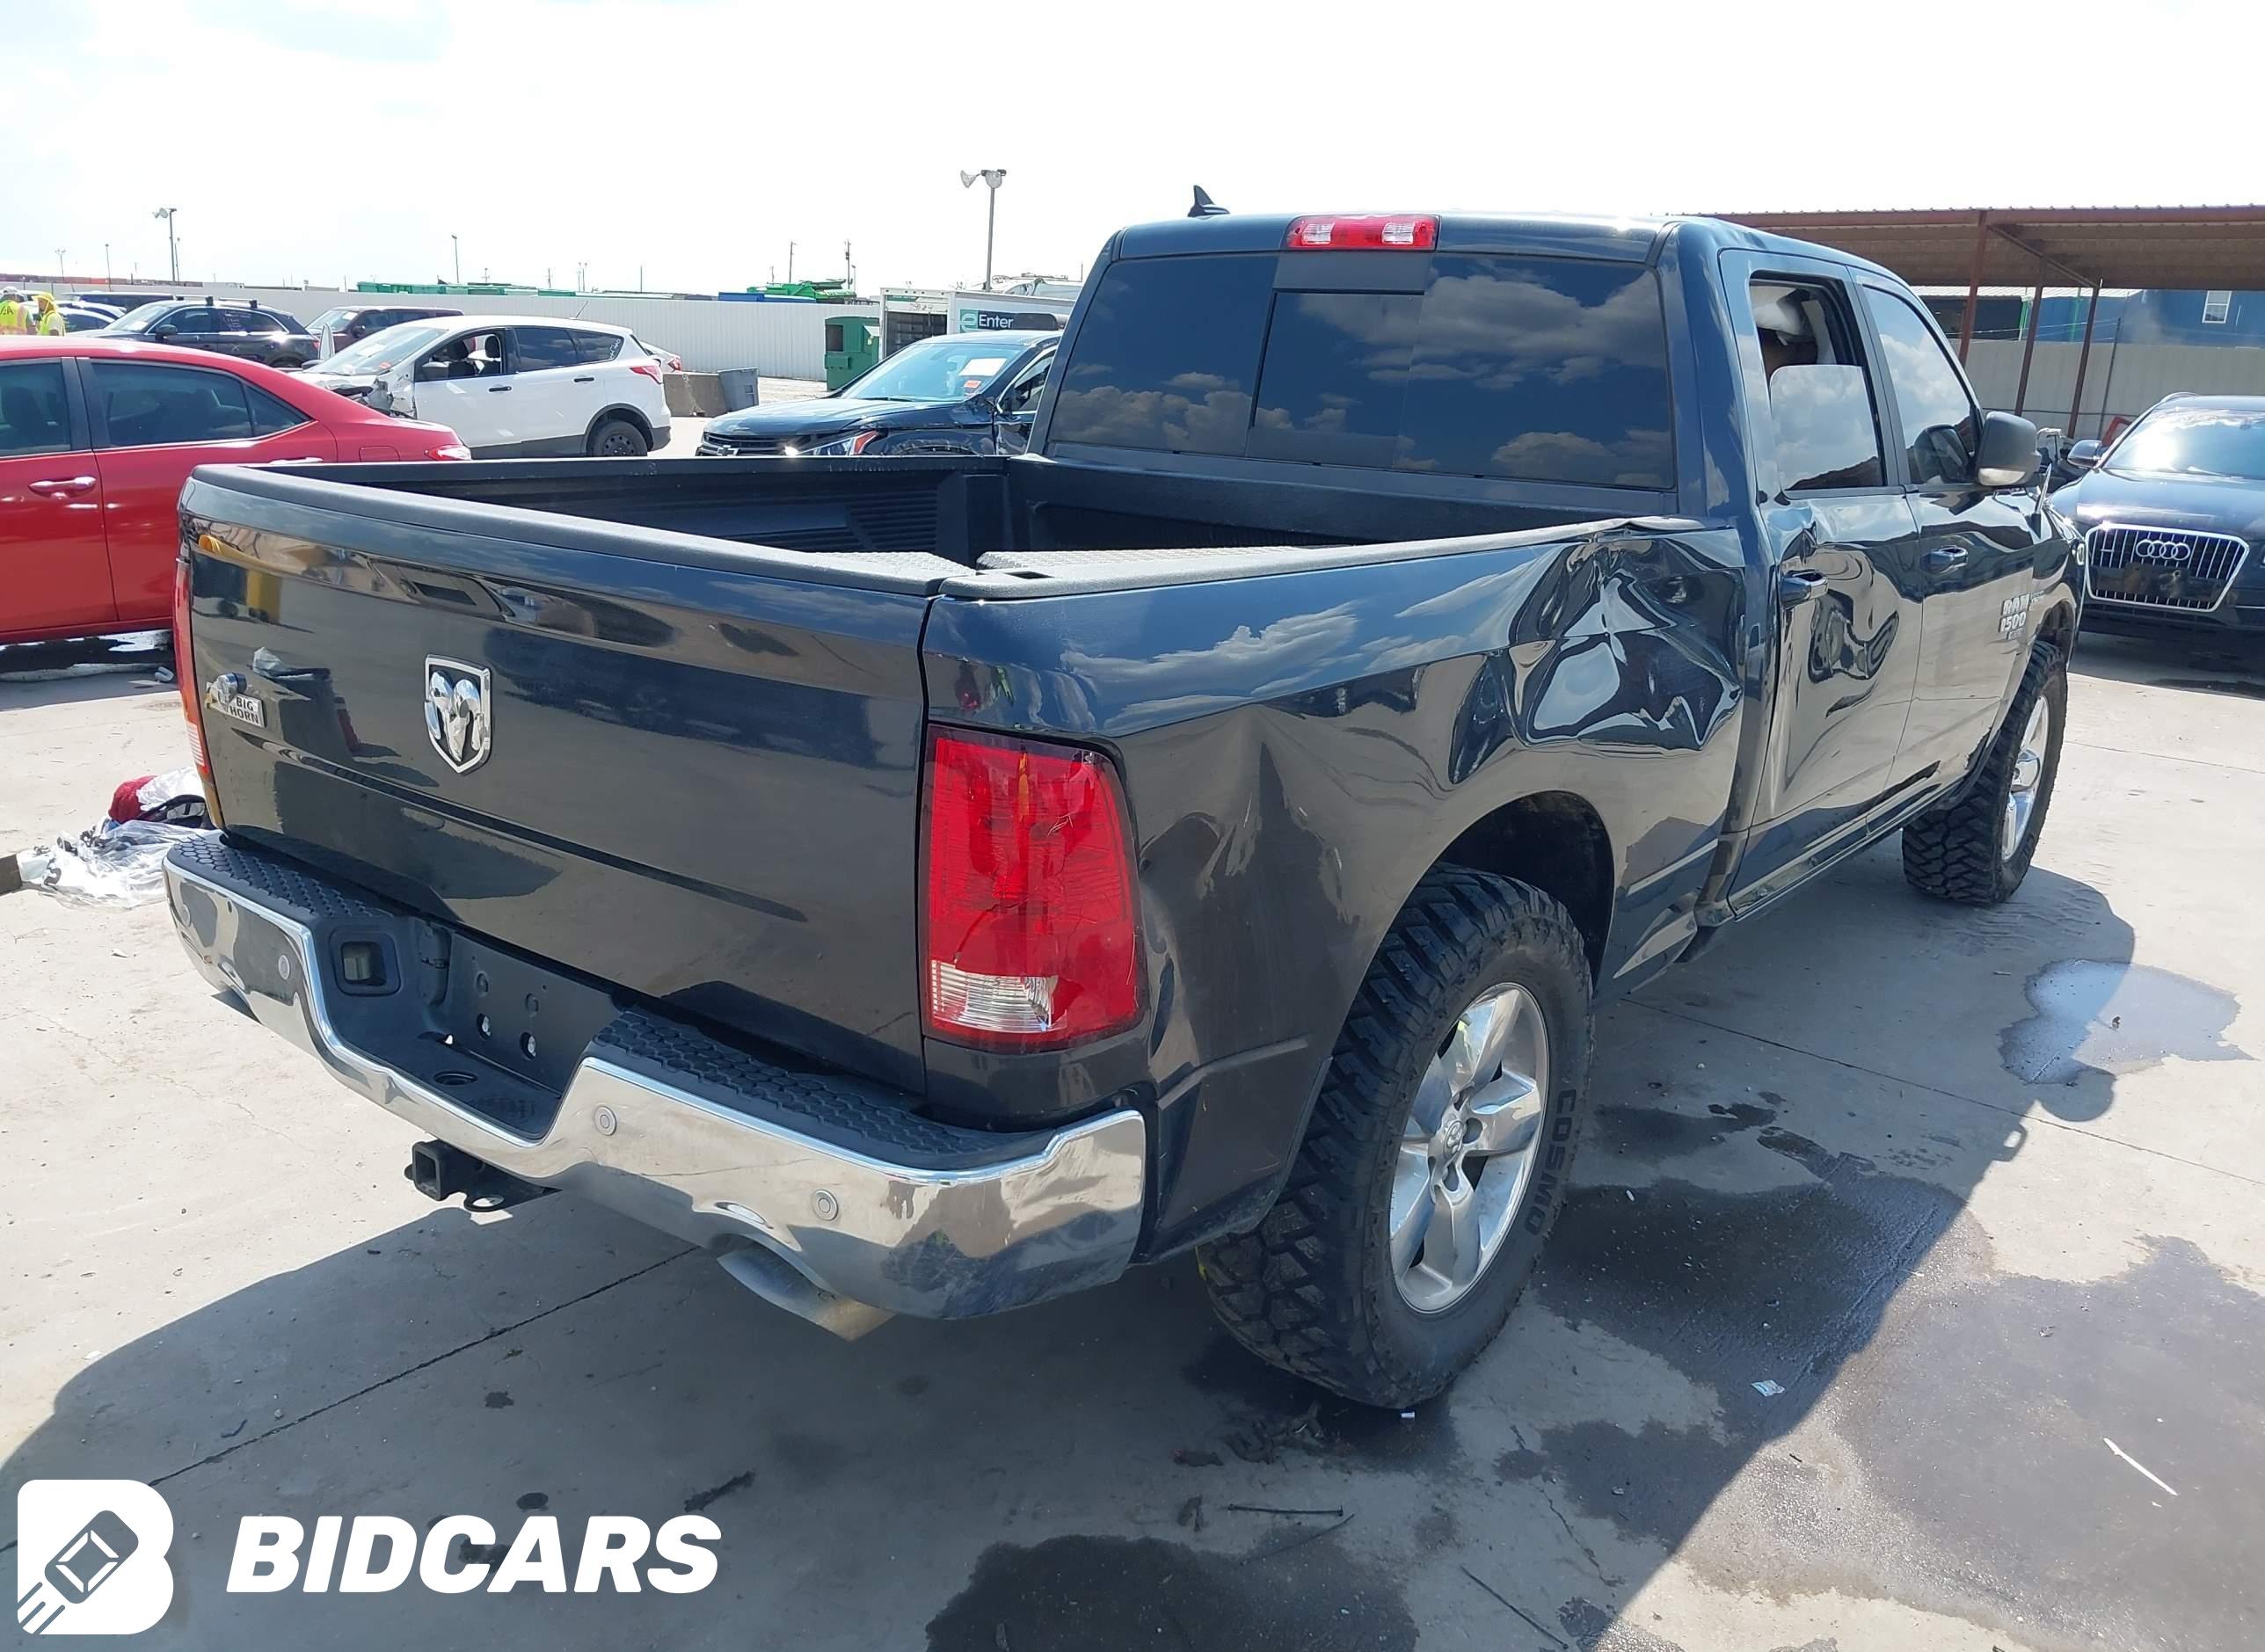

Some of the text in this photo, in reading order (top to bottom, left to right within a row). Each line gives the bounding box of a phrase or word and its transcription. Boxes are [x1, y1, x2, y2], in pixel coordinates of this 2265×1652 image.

[979, 314, 1014, 329] Enter
[2001, 593, 2031, 615] RAM
[1998, 611, 2027, 633] 1500
[236, 696, 254, 712] BIG
[229, 705, 259, 724] HORN
[1524, 1088, 1577, 1235] COSMO
